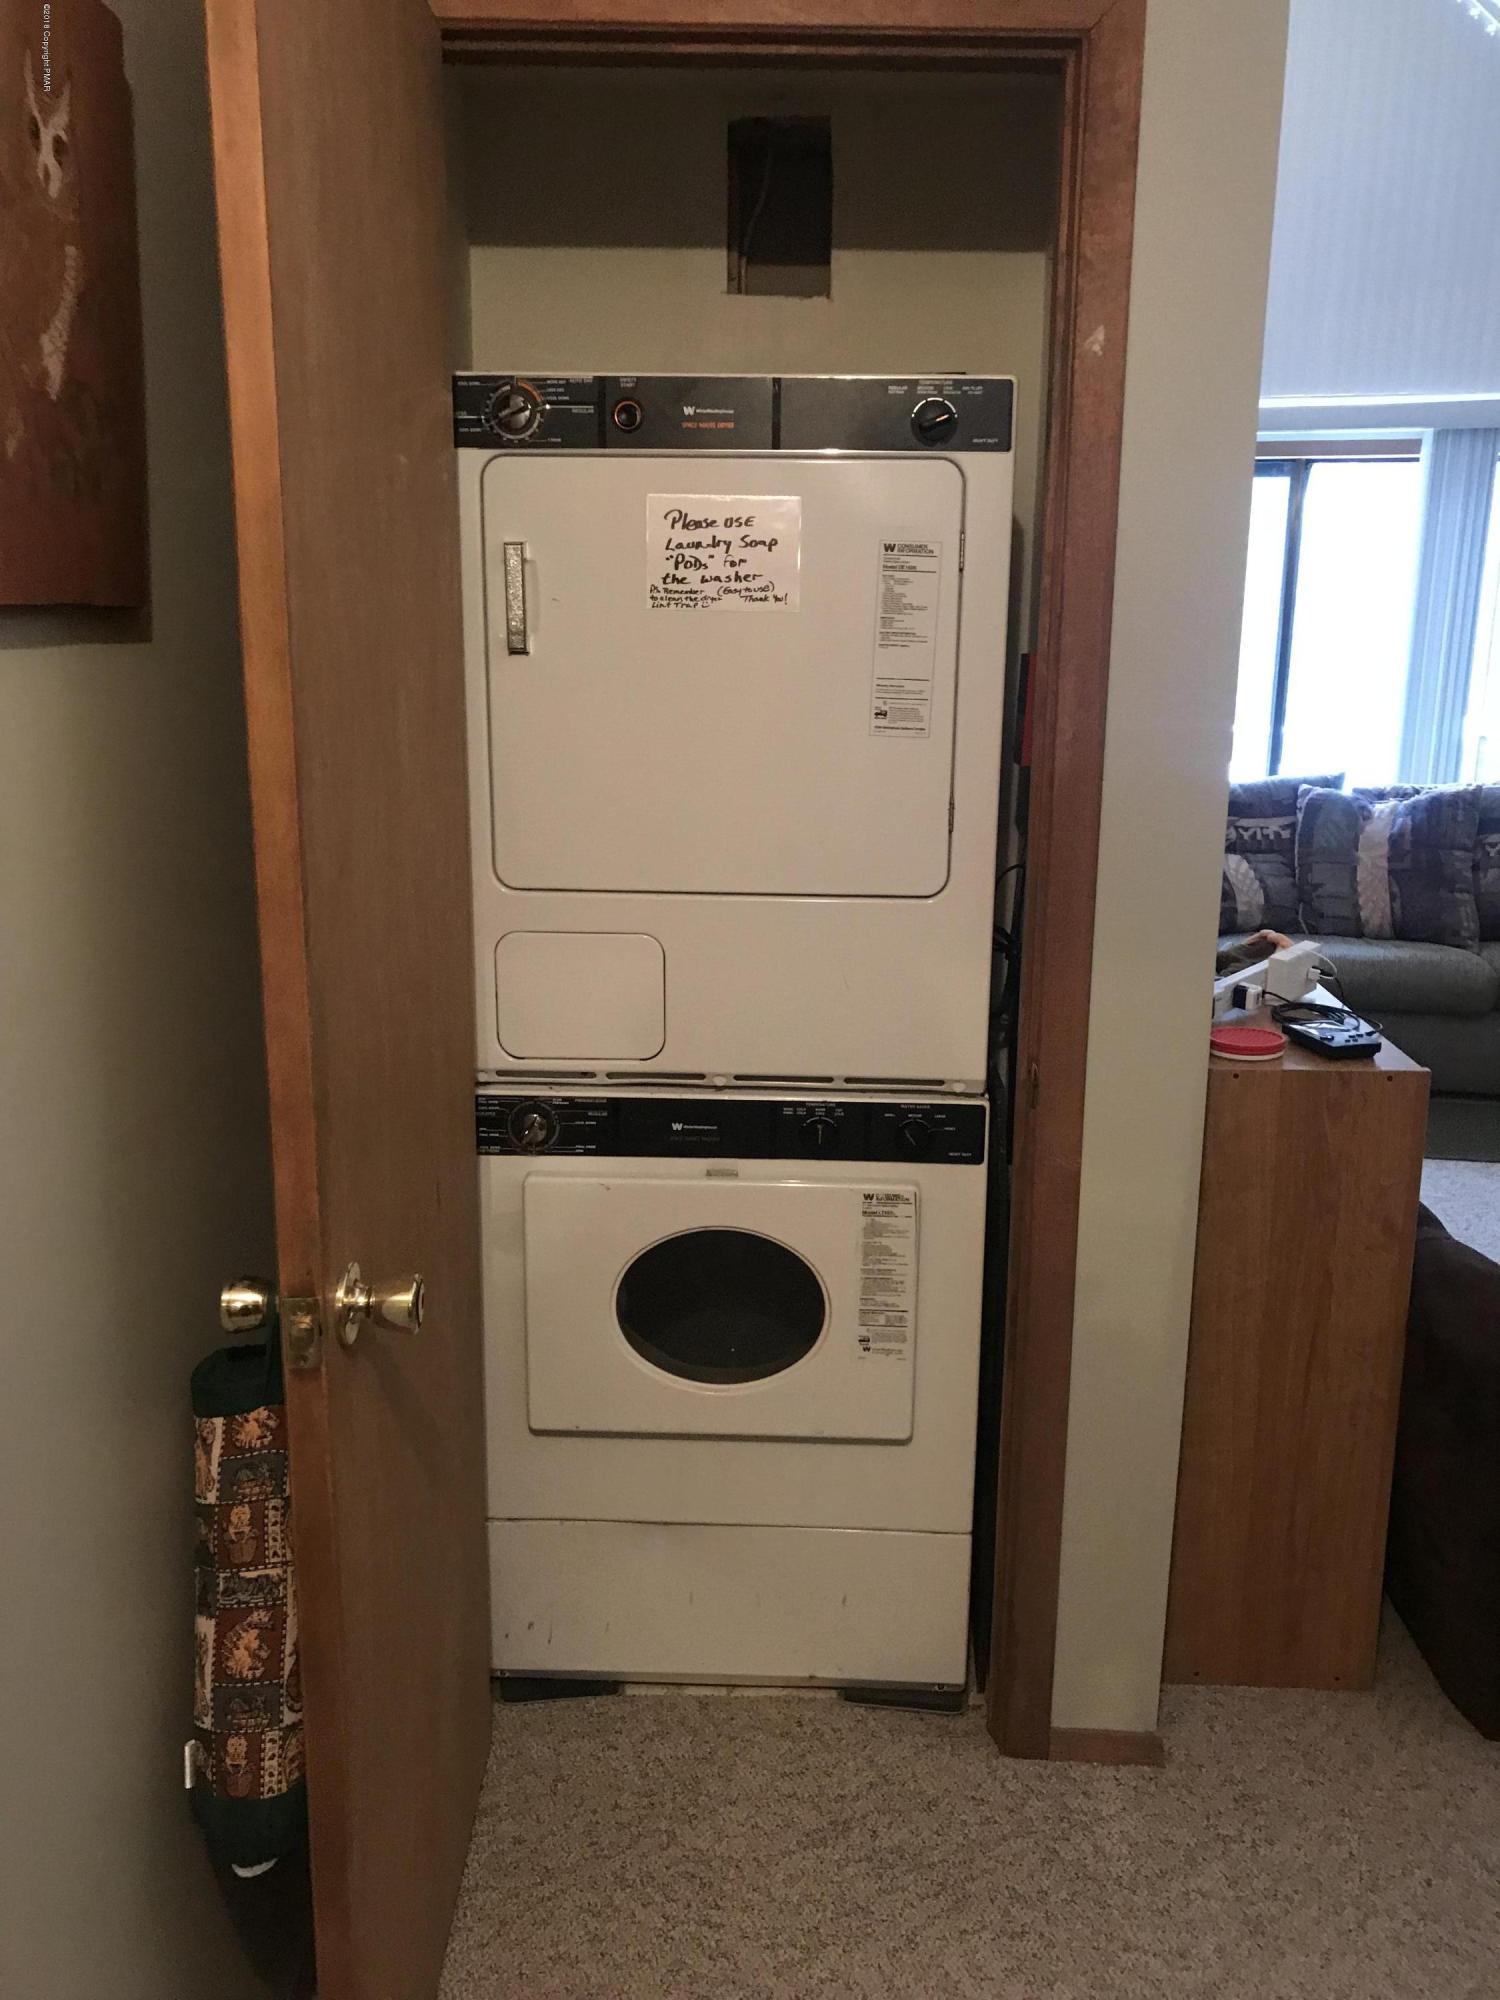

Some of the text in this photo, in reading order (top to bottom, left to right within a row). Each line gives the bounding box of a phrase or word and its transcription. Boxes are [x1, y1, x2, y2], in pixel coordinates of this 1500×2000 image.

[663, 508, 719, 531] Please
[665, 534, 779, 555] Laundry Soap
[883, 543, 896, 552] W
[661, 571, 763, 585] the washer
[740, 594, 770, 603] Thank
